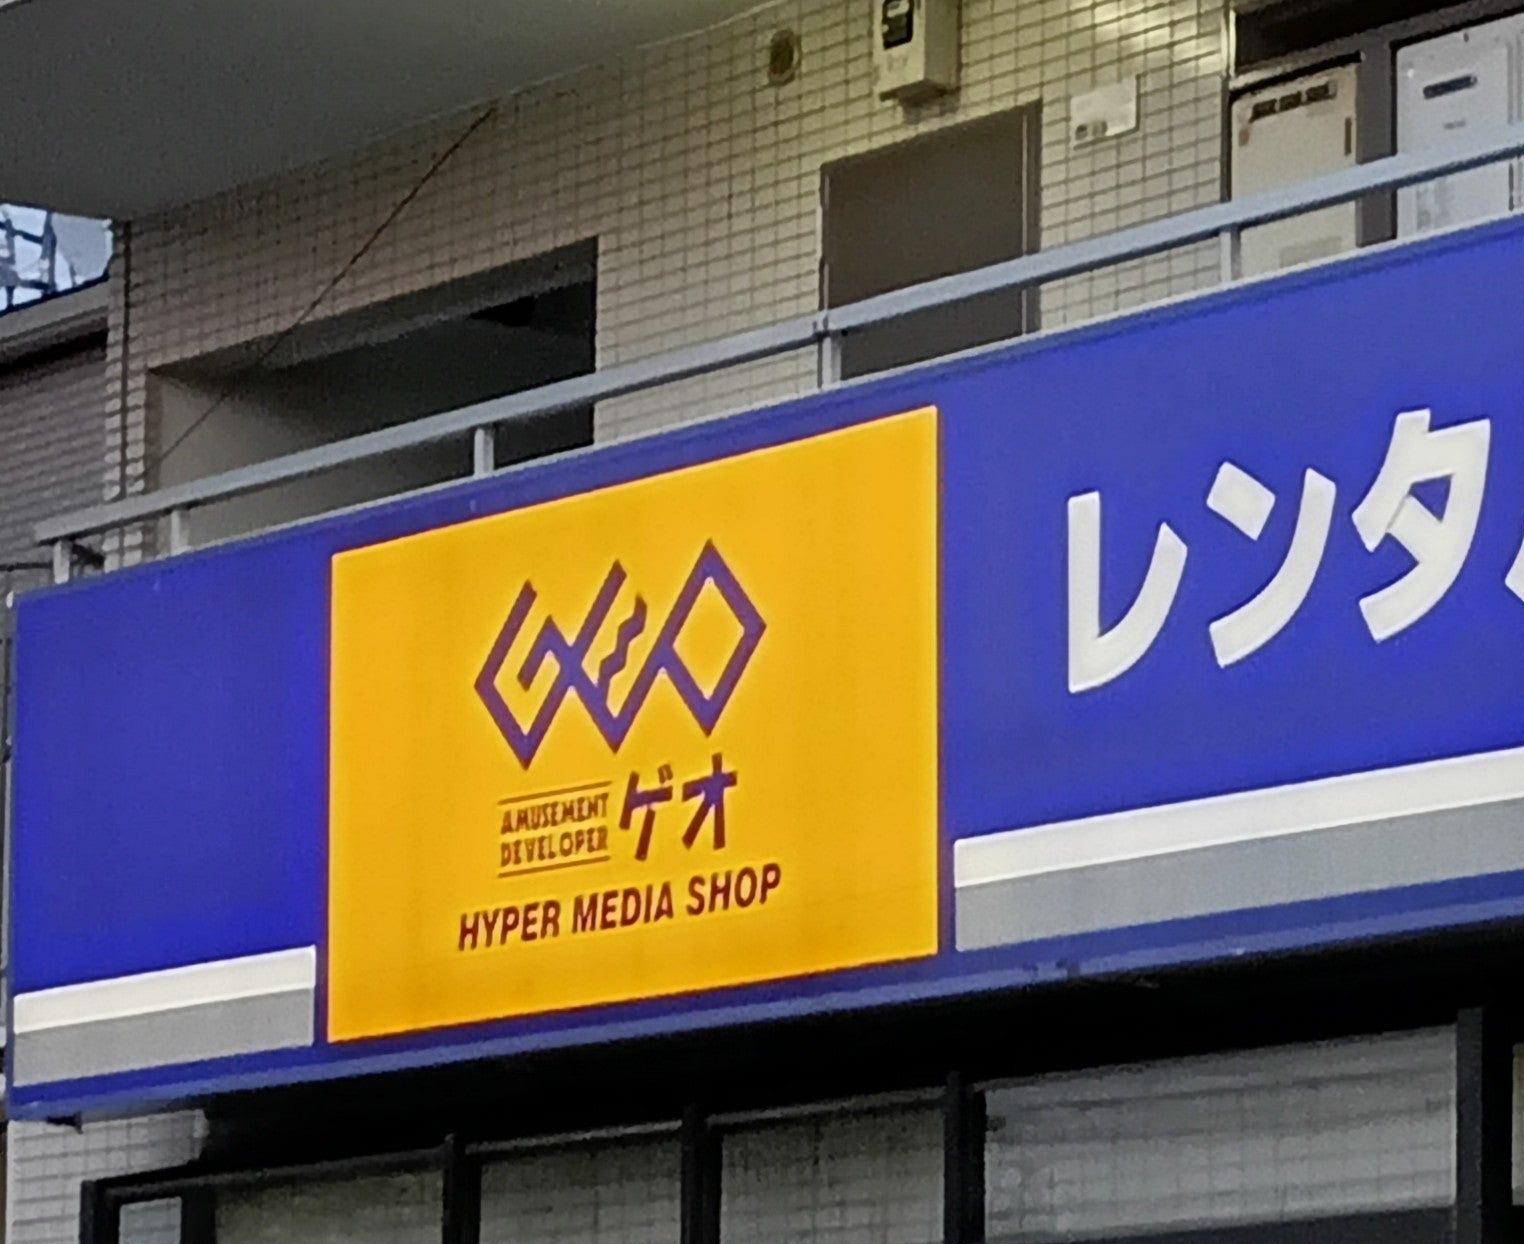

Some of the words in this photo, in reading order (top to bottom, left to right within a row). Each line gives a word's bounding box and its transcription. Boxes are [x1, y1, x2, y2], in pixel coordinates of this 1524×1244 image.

[499, 792, 610, 835] AMUSEMENT
[618, 752, 738, 862] ゲオ
[499, 825, 609, 868] DEVELOPER
[457, 900, 561, 952] HYPER
[571, 881, 674, 935] MEDIA
[686, 863, 782, 916] SHOP
